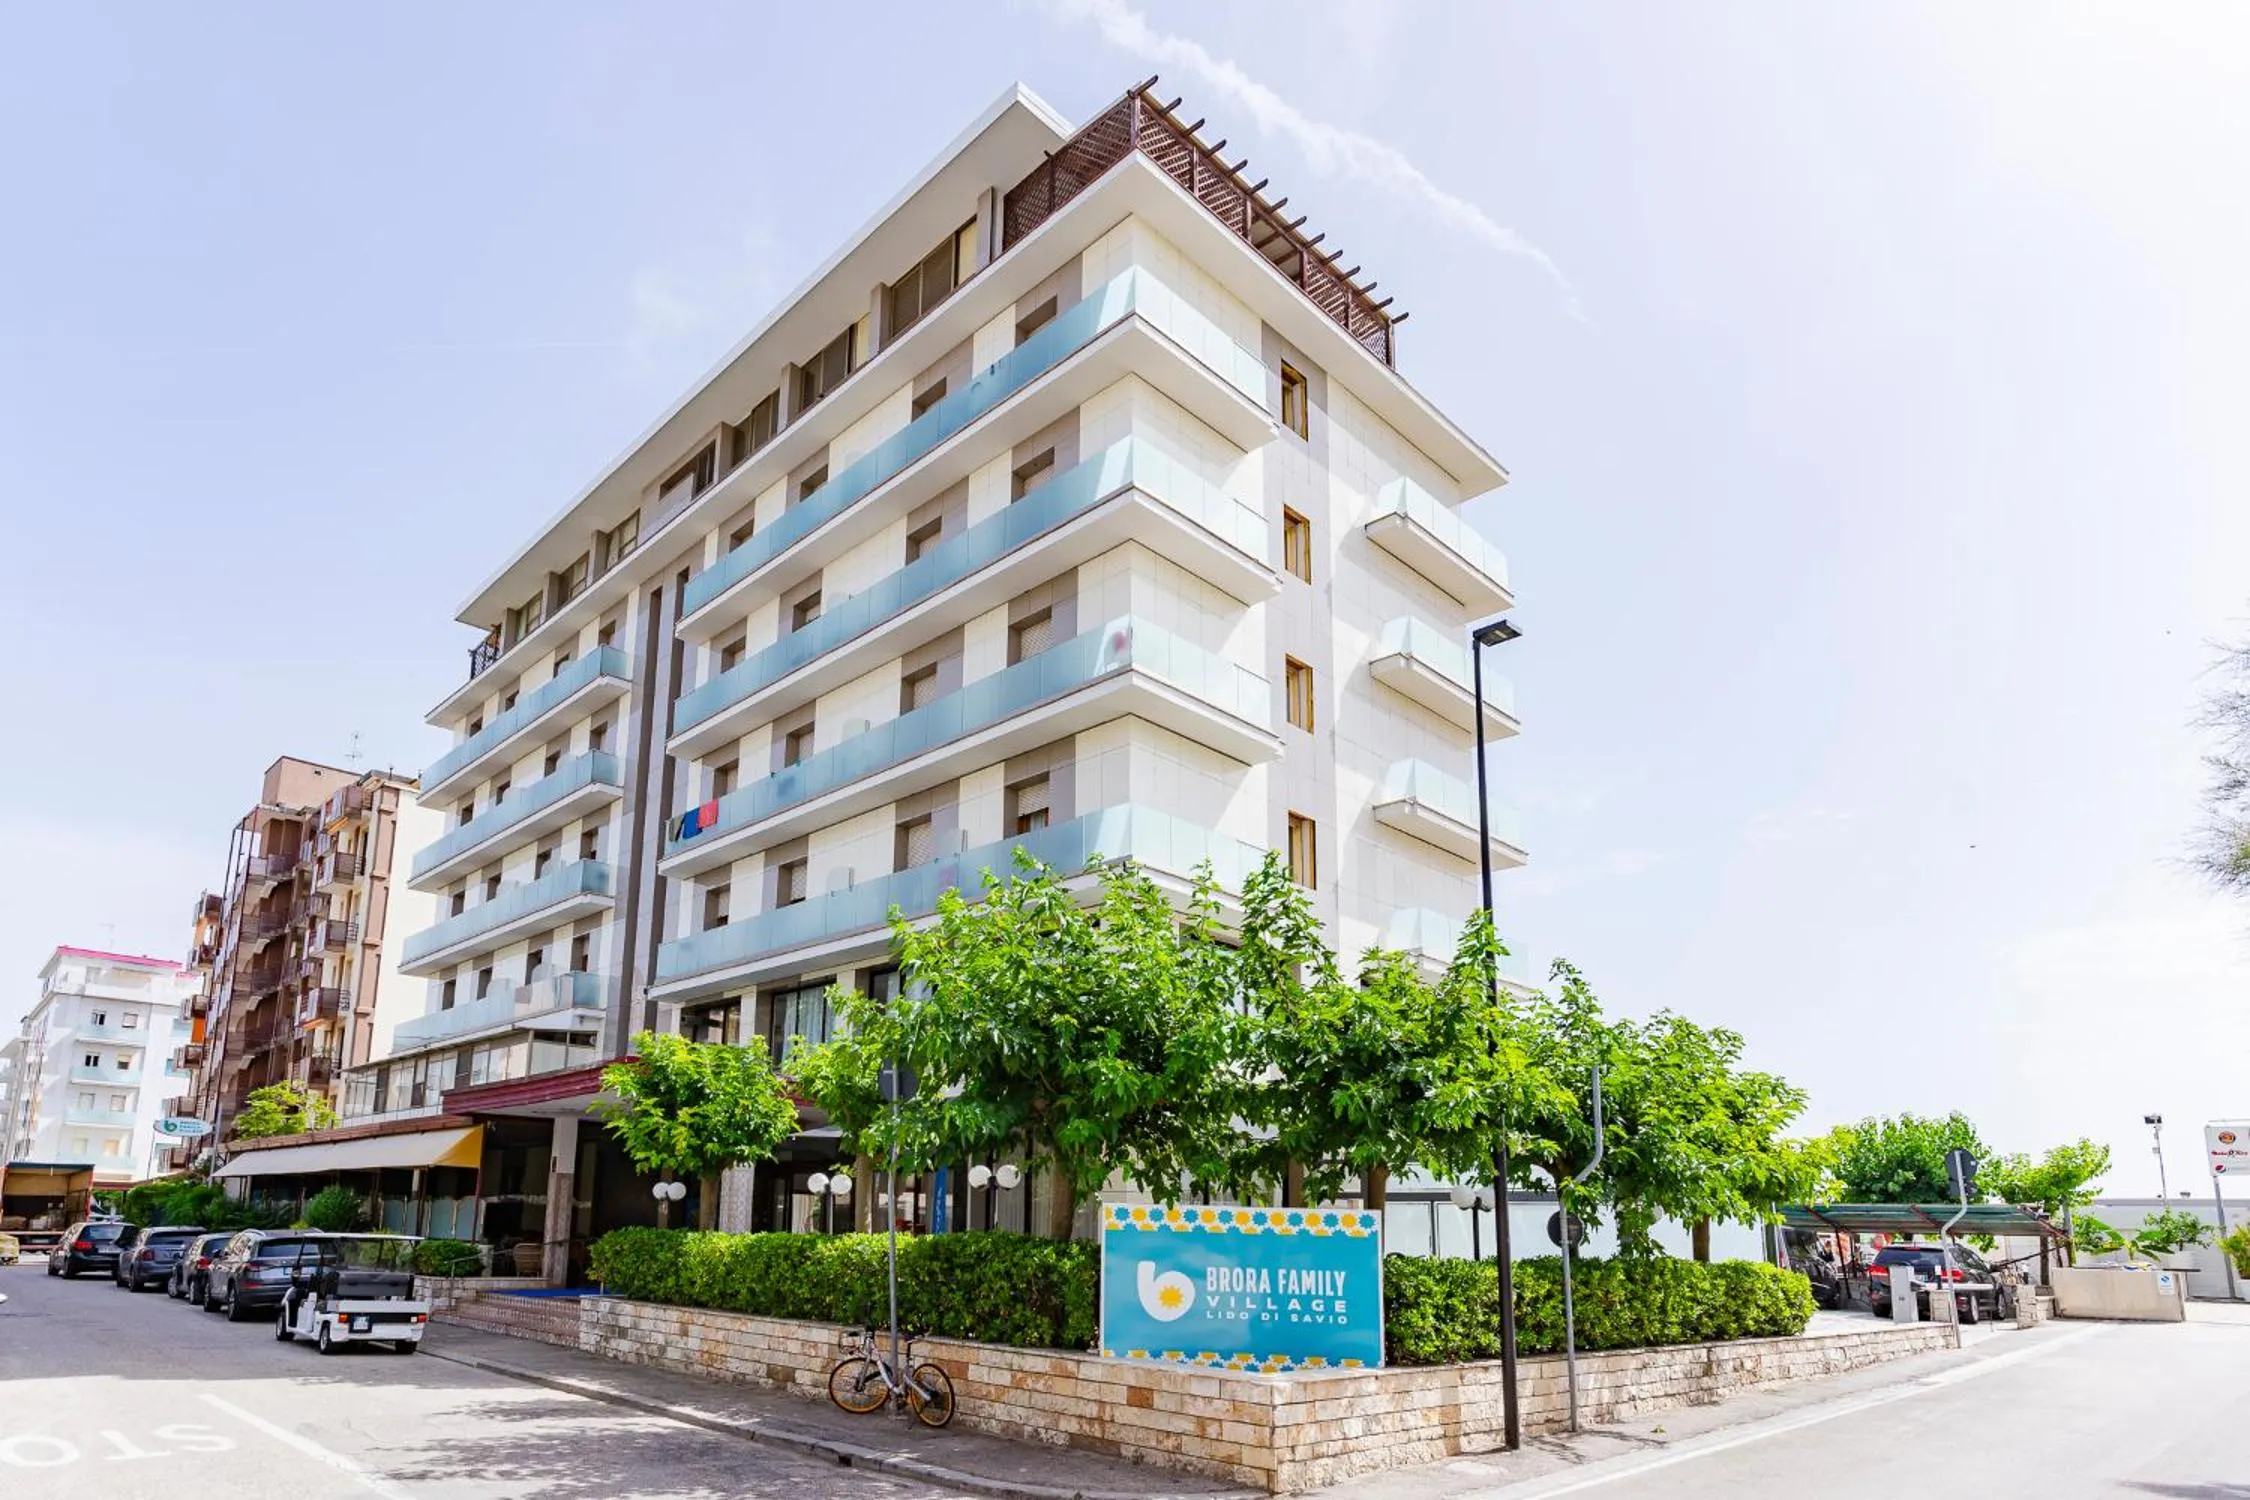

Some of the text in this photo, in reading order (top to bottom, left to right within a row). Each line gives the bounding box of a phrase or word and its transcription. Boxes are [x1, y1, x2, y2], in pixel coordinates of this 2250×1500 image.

[1206, 1266, 1346, 1297] BRORA FAMILY
[1206, 1295, 1347, 1313] VILLAGE
[1206, 1310, 1348, 1325] LIDO DI SAVIO
